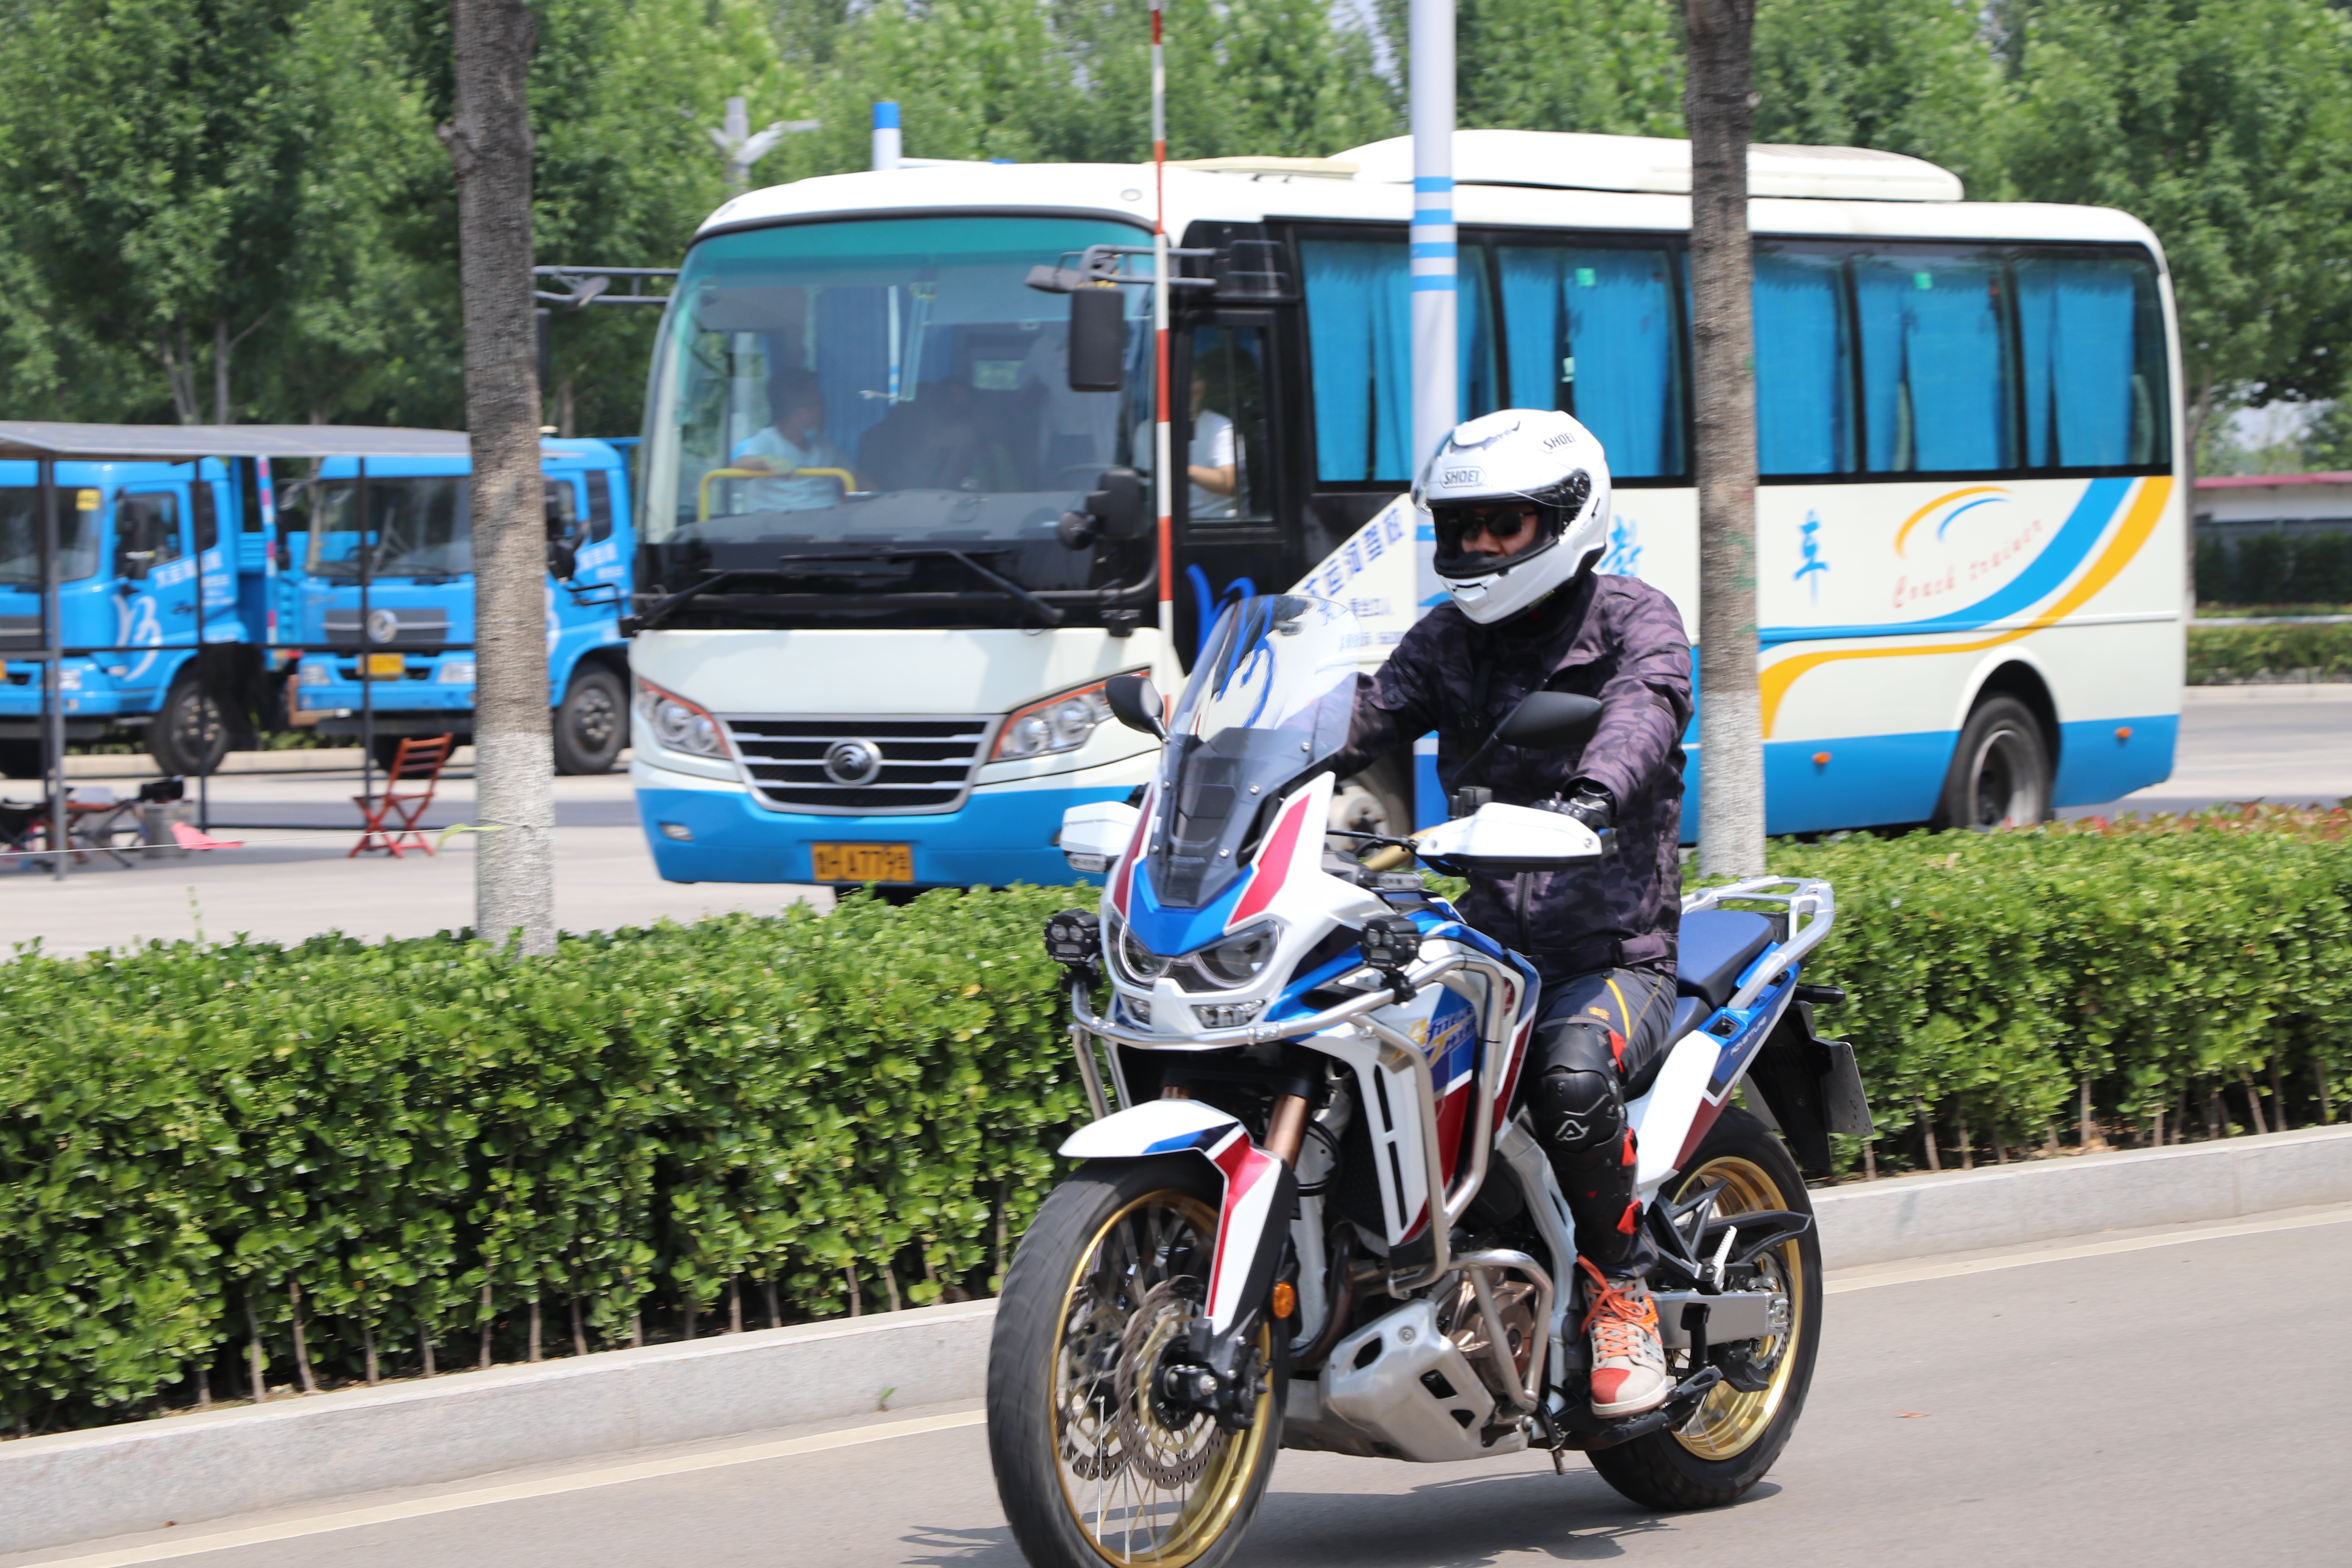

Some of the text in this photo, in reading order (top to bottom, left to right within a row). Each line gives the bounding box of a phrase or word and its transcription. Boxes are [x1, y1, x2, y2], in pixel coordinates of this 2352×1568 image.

[1543, 432, 1577, 450] SHOEI
[1445, 470, 1481, 485] SHOEI
[1794, 509, 1830, 606] 车
